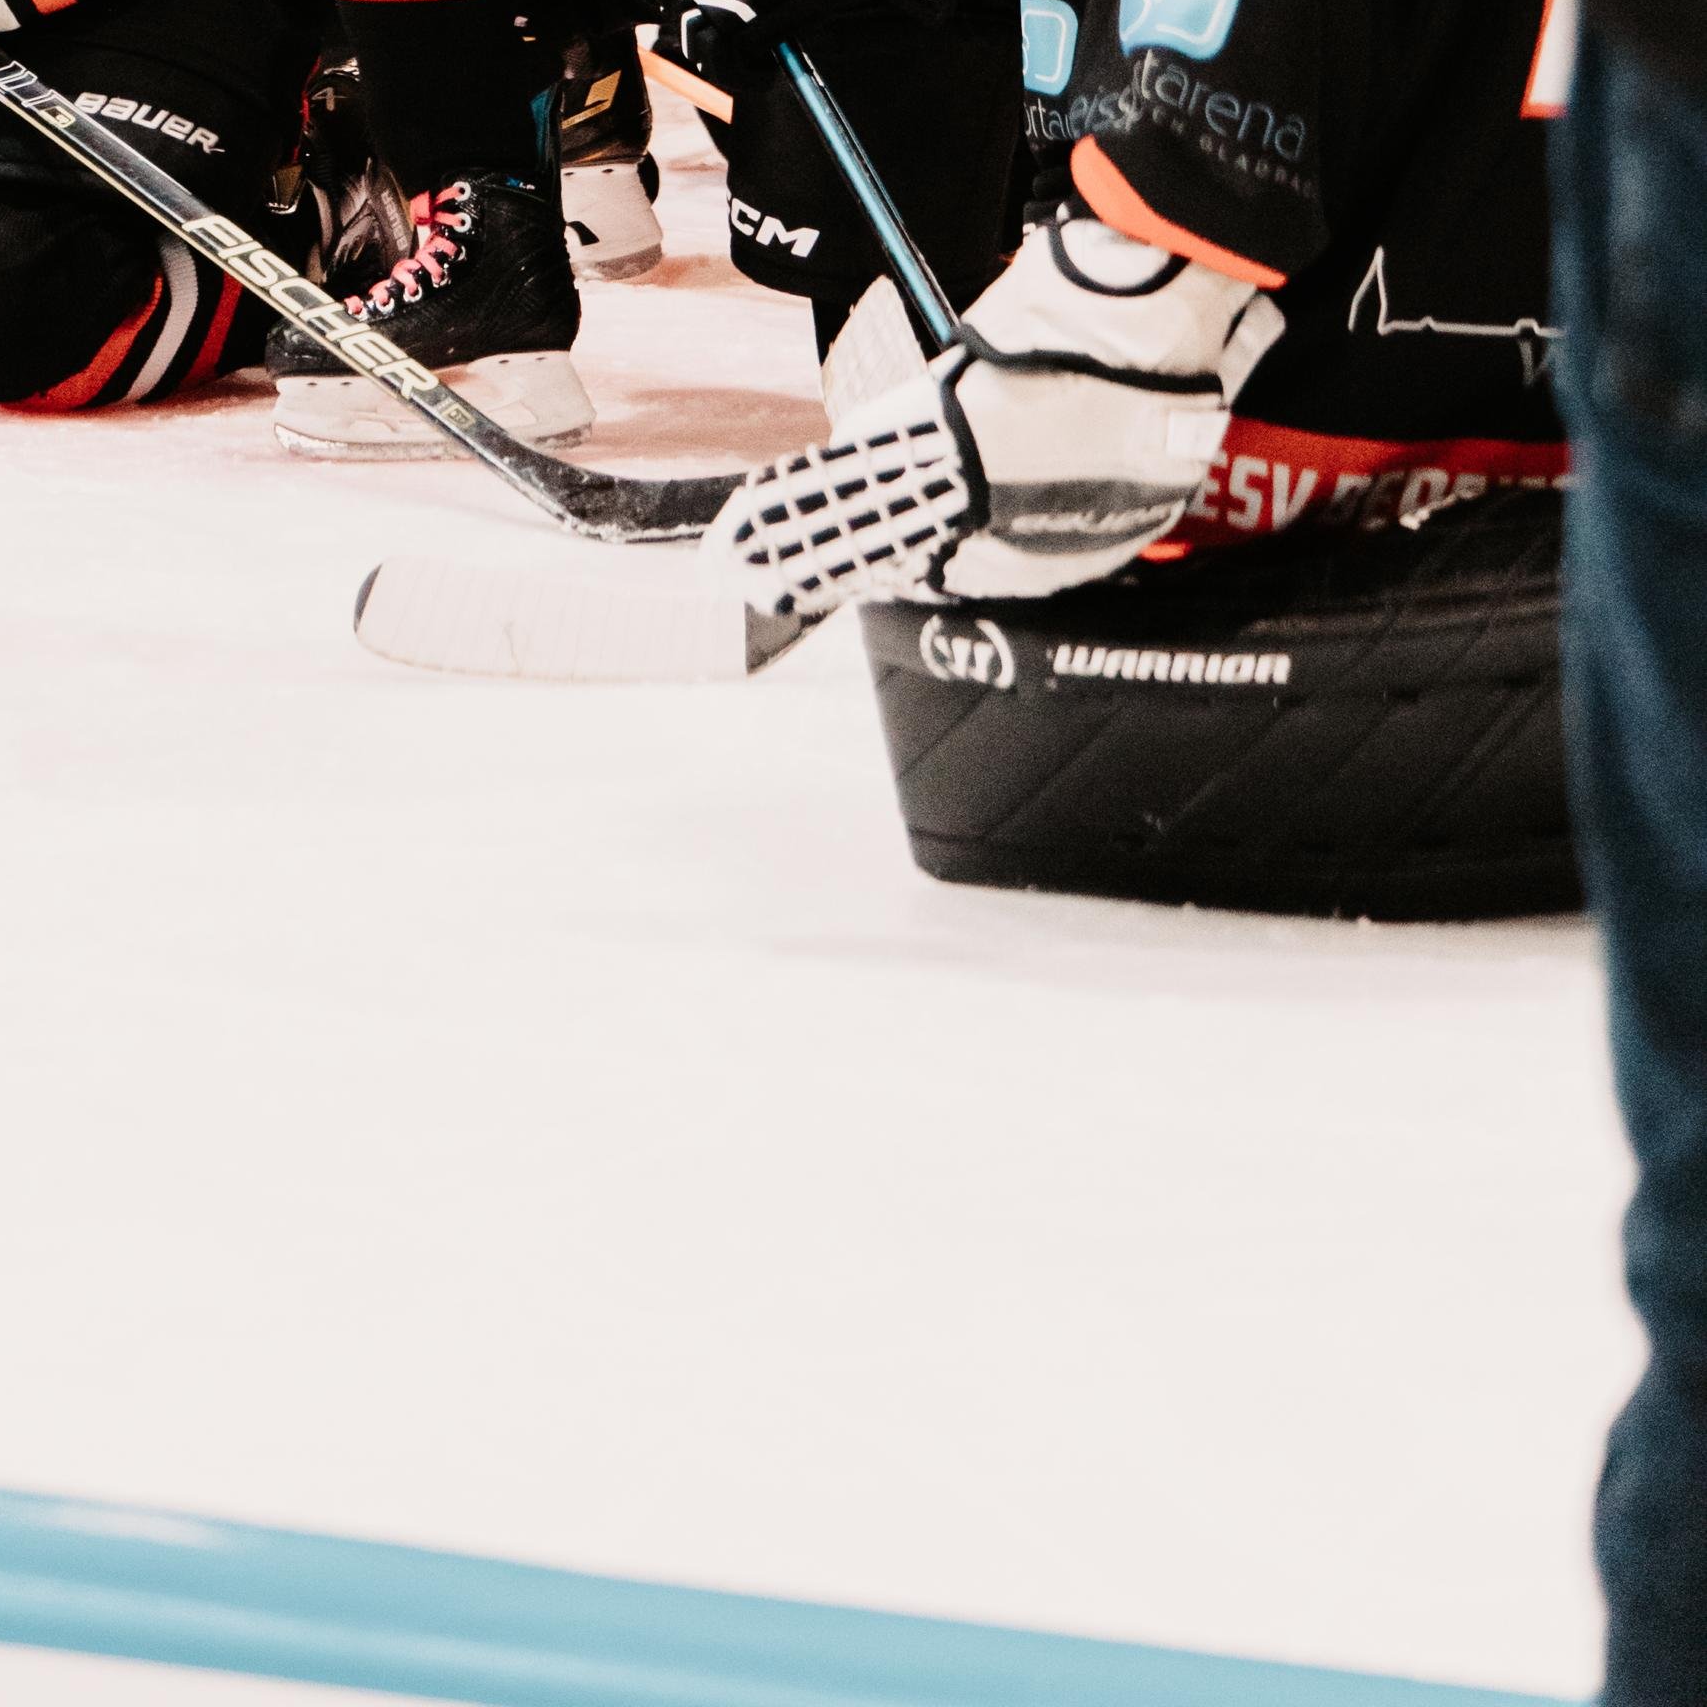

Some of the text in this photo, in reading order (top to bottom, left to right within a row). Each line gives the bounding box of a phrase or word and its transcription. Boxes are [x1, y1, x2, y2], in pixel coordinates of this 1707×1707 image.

[73, 90, 226, 155] BAUER
[727, 198, 821, 259] CM
[182, 214, 440, 399] FISCHER
[1053, 642, 1292, 685] WARRIOR
